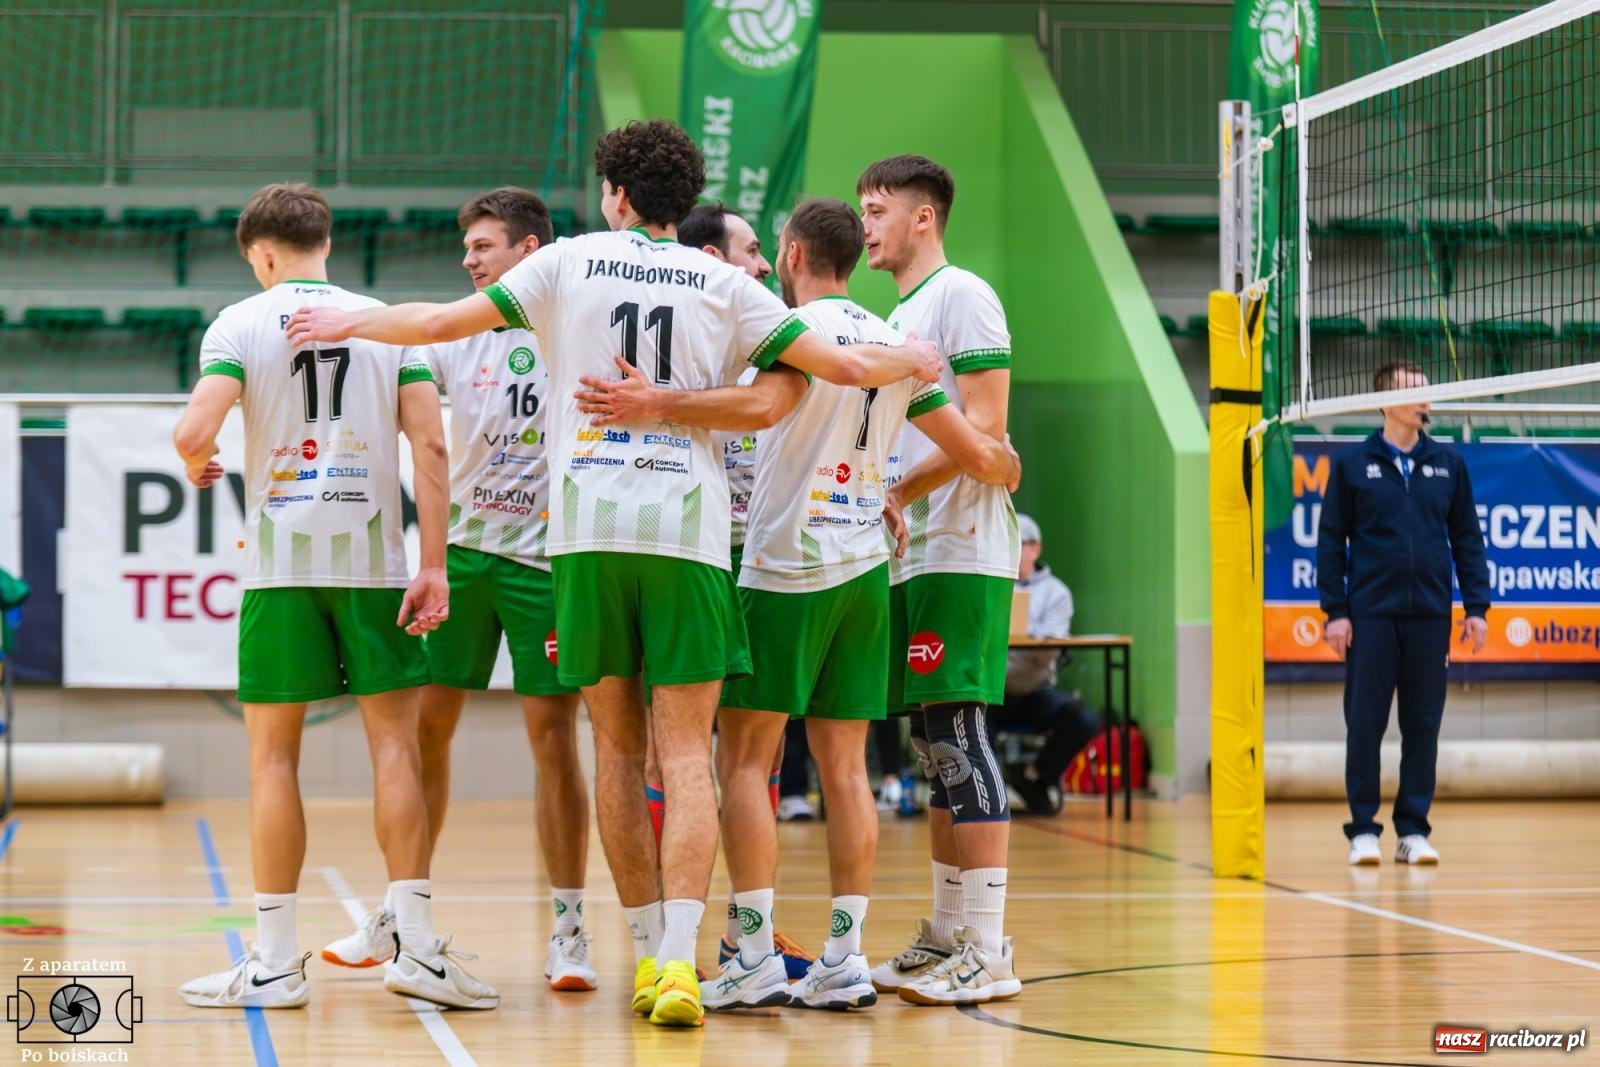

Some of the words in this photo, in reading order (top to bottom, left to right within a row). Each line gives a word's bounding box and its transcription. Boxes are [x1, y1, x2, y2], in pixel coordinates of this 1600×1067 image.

[585, 259, 706, 291] JAKUBOWSKI
[610, 301, 674, 384] 11
[290, 347, 350, 423] 17
[505, 382, 539, 419] 16
[644, 434, 691, 446] ENTECO
[271, 444, 298, 457] radio
[571, 457, 625, 466] UBEZPIECZENIA
[655, 459, 685, 468] CONCEPT
[655, 466, 689, 475] automatic
[816, 465, 833, 477] radio
